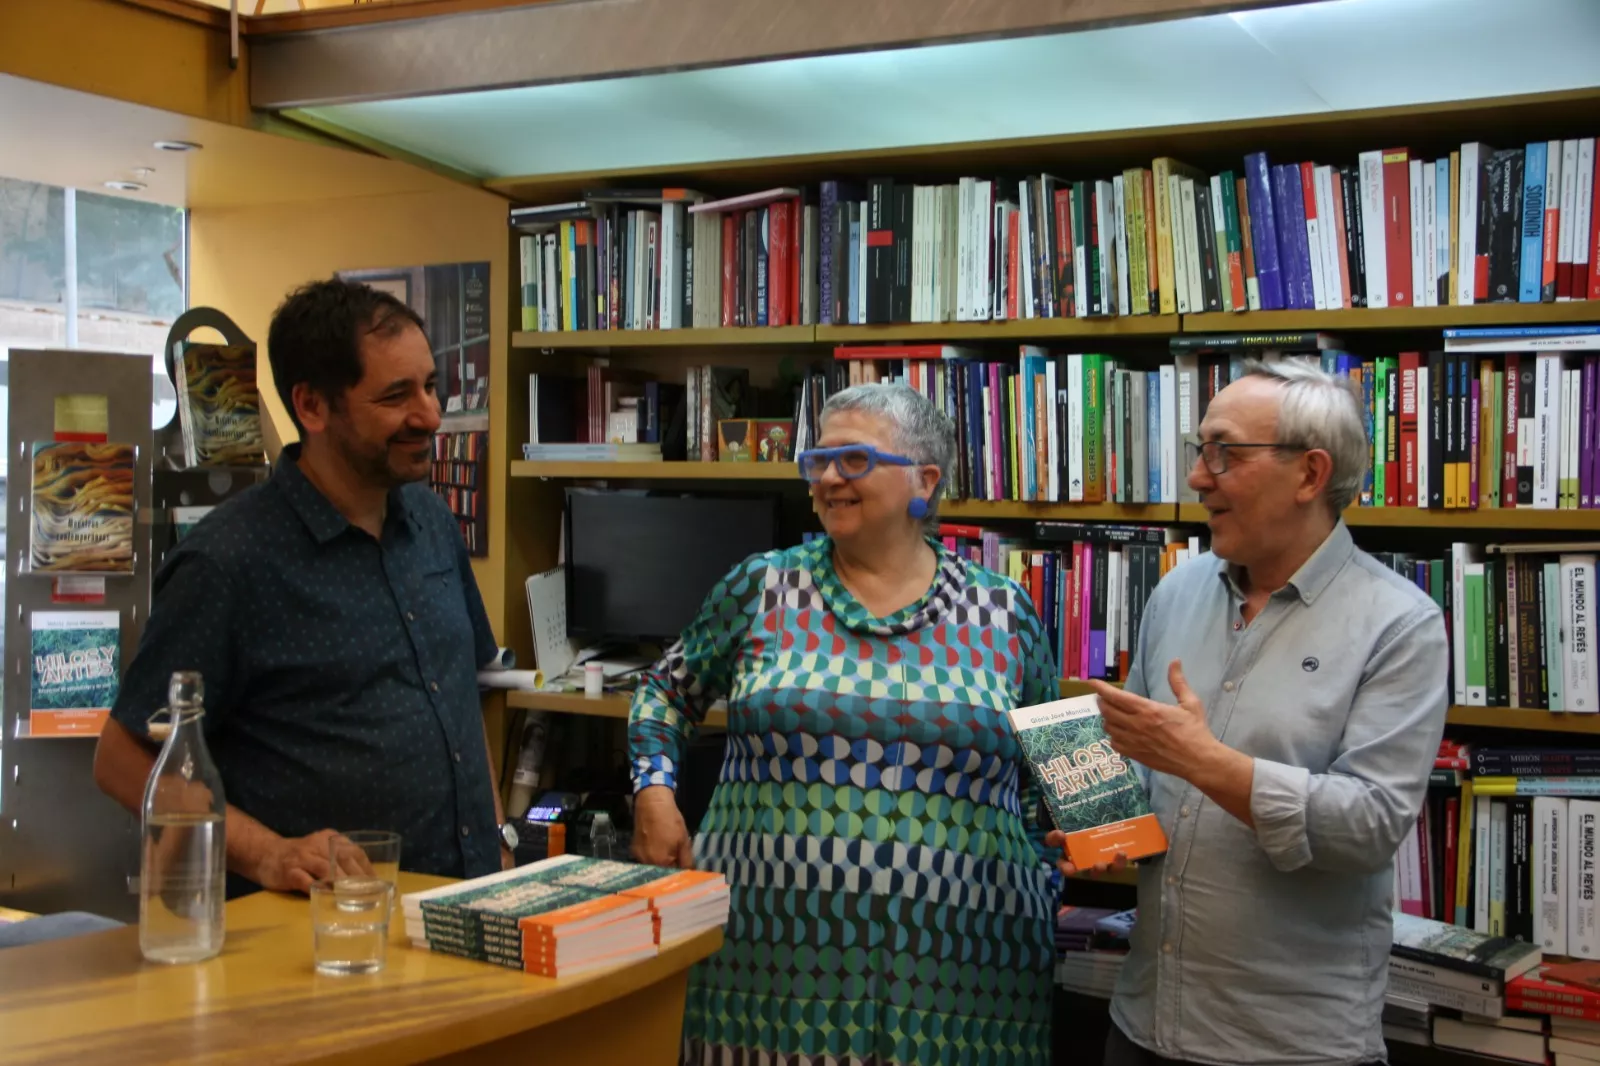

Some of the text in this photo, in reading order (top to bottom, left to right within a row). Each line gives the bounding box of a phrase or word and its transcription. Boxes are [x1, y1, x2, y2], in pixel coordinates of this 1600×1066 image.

[1501, 159, 1512, 213] INTOLERANCIA
[1523, 184, 1543, 238] HUNDIDOS
[1242, 337, 1273, 345] LENGUA
[1403, 369, 1415, 414] IGUALDAD
[1088, 411, 1096, 482] GUERRA CIVIL
[1575, 567, 1588, 654] EL MUNDO AL REVÉS
[35, 644, 117, 674] HILOS Y
[40, 660, 115, 687] ARTES
[1038, 743, 1107, 786] HILOS
[1054, 753, 1128, 801] ARTES
[1583, 814, 1595, 901] EL MUNDO AL REVÉS
